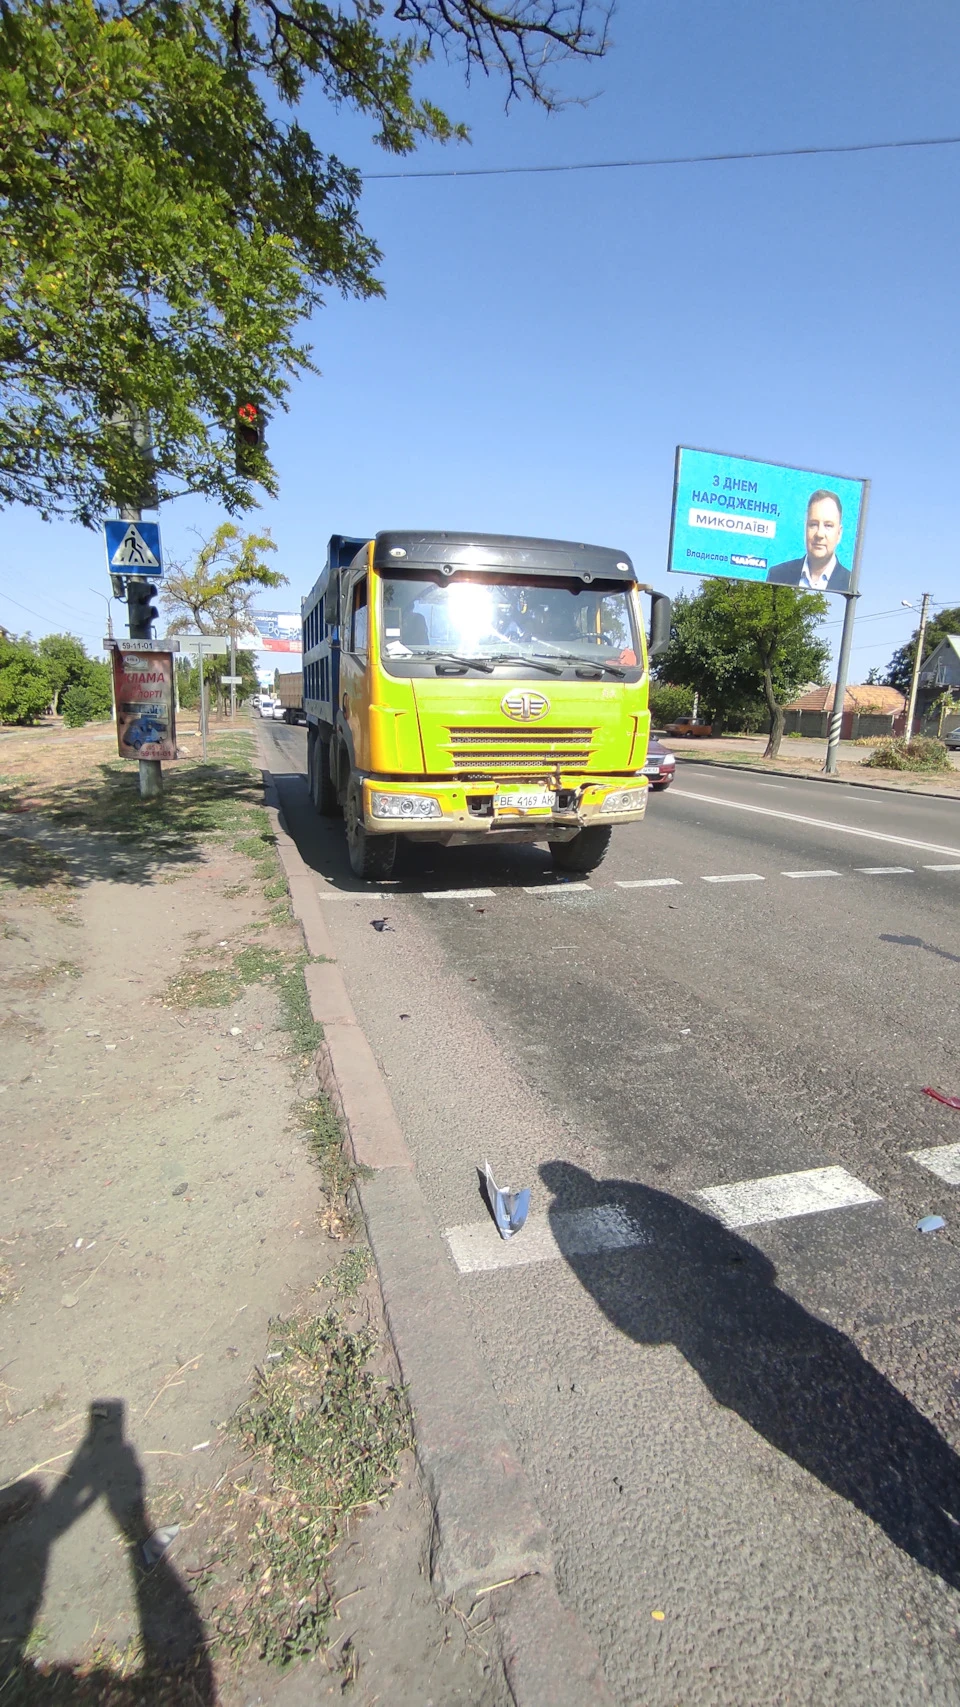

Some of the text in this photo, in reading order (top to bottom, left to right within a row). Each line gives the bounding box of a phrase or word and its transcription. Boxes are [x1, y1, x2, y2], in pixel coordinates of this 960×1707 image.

[712, 475, 758, 493] З ДНЕМ
[692, 490, 781, 517] НАРОДЖЕННЯ,
[696, 514, 769, 534] МИКОЛАЇВ!
[686, 549, 729, 562] Владислав
[122, 642, 153, 650] 59-11-01
[125, 672, 165, 684] КЛАМА
[500, 794, 554, 806] BE 4169 AK
